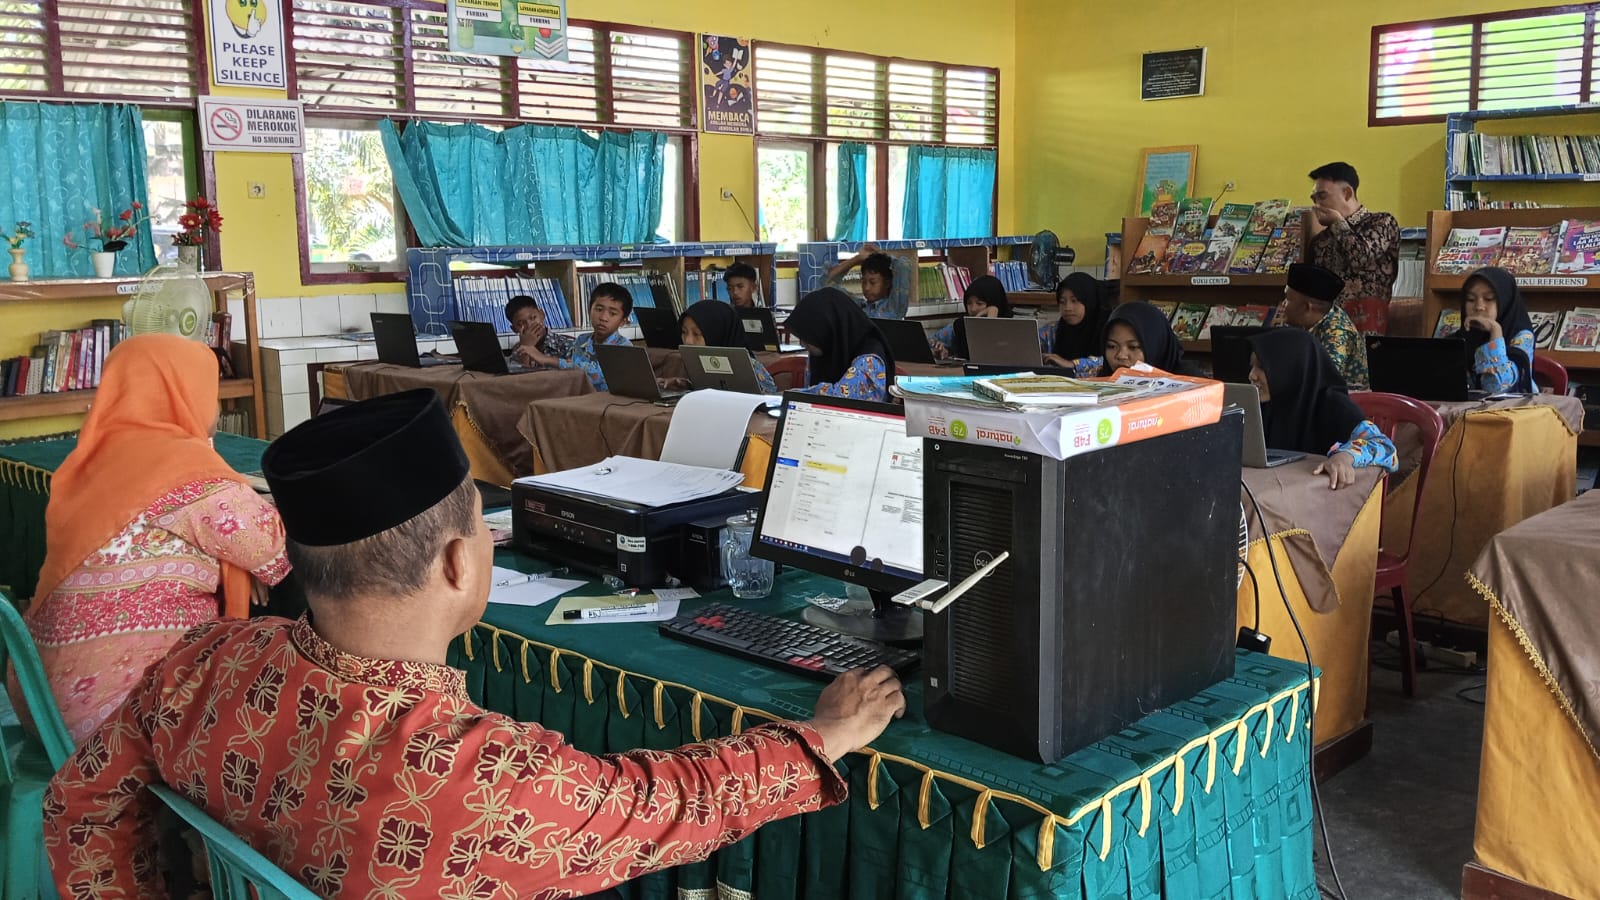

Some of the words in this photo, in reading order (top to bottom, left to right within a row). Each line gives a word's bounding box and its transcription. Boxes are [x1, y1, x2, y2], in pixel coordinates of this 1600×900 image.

[223, 42, 275, 56] PLEASE
[232, 57, 267, 68] KEEP
[221, 69, 280, 83] SILENCE
[246, 108, 296, 120] DILARANG
[708, 110, 750, 123] MEMBACA
[247, 121, 298, 132] MEROKOK
[264, 136, 294, 144] SMOKING
[1538, 278, 1585, 286] REFERENSI
[928, 425, 947, 437] F4B
[953, 426, 965, 436] 75
[976, 429, 1013, 443] natural
[1074, 434, 1091, 447] F4B
[1100, 426, 1110, 438] 75
[1128, 418, 1158, 433] natural
[561, 510, 575, 519] EPSON
